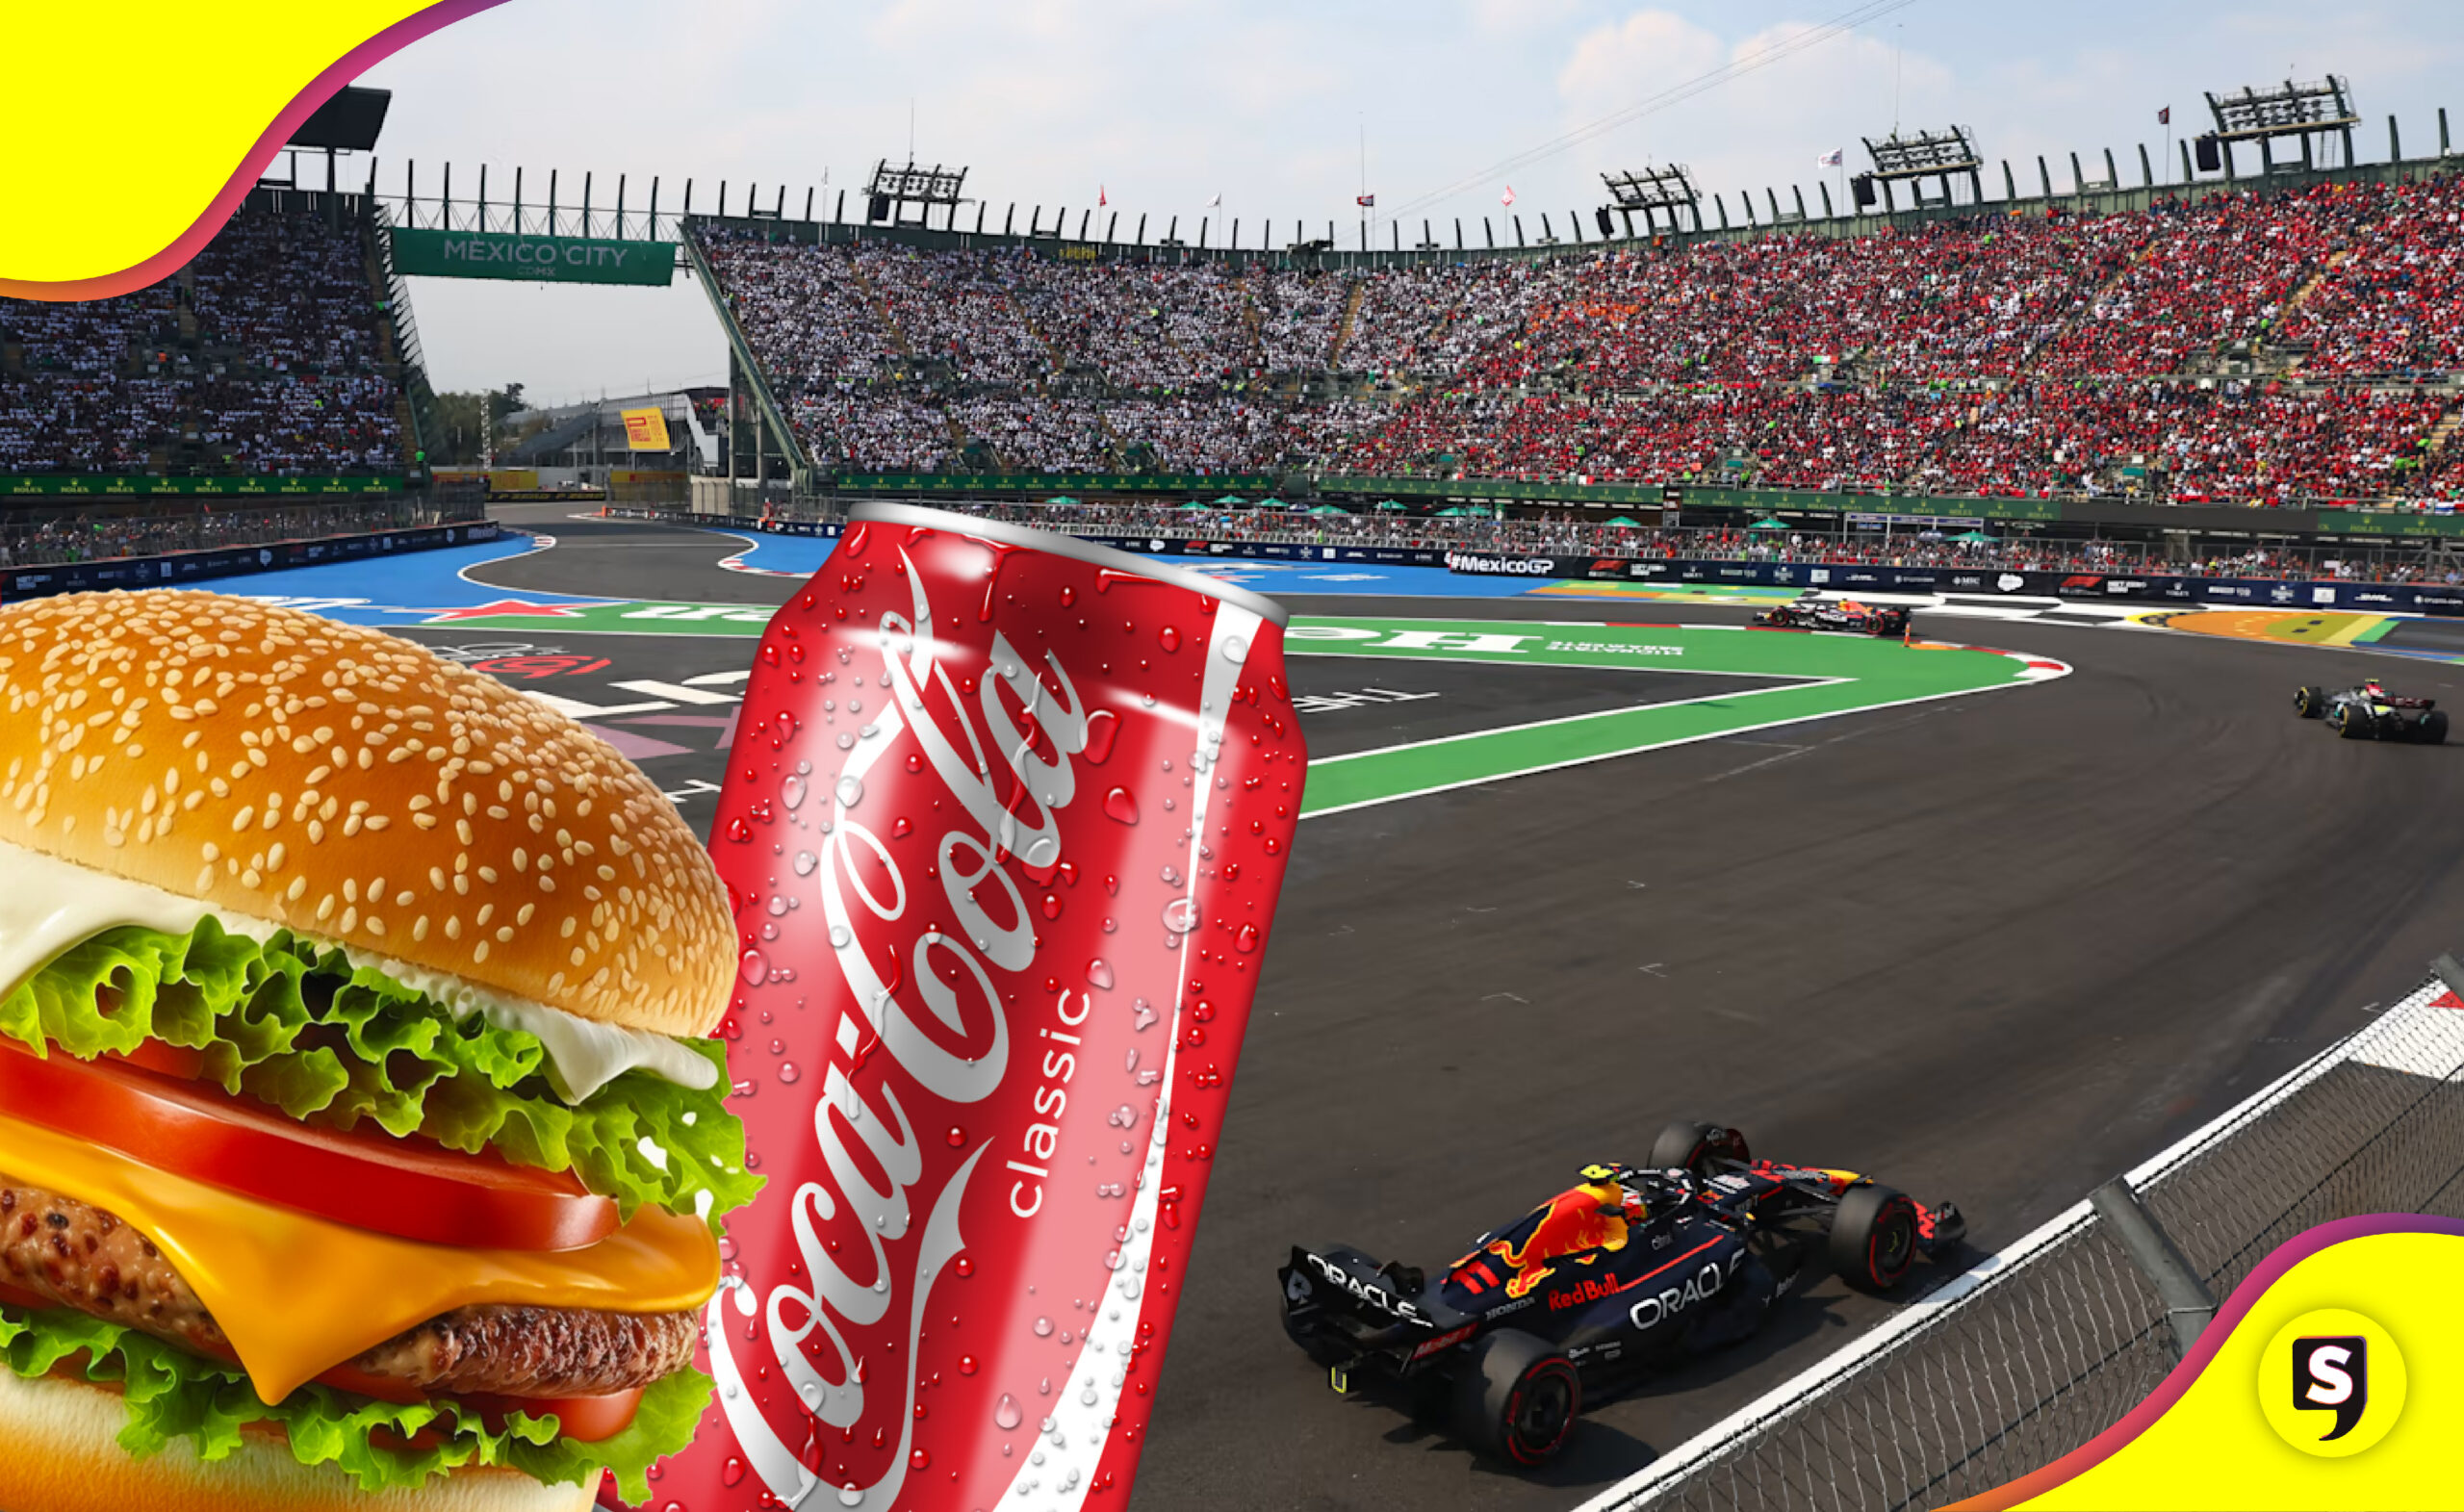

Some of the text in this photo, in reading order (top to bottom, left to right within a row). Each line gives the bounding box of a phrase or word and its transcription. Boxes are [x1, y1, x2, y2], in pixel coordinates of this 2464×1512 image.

[566, 245, 629, 268] CITY
[1450, 553, 1555, 575] #MexicoGP
[708, 544, 1089, 1512] Coca-Cola
[1007, 988, 1091, 1218] classic
[1450, 1261, 1501, 1294] 11
[1486, 1296, 1536, 1321] HONDA
